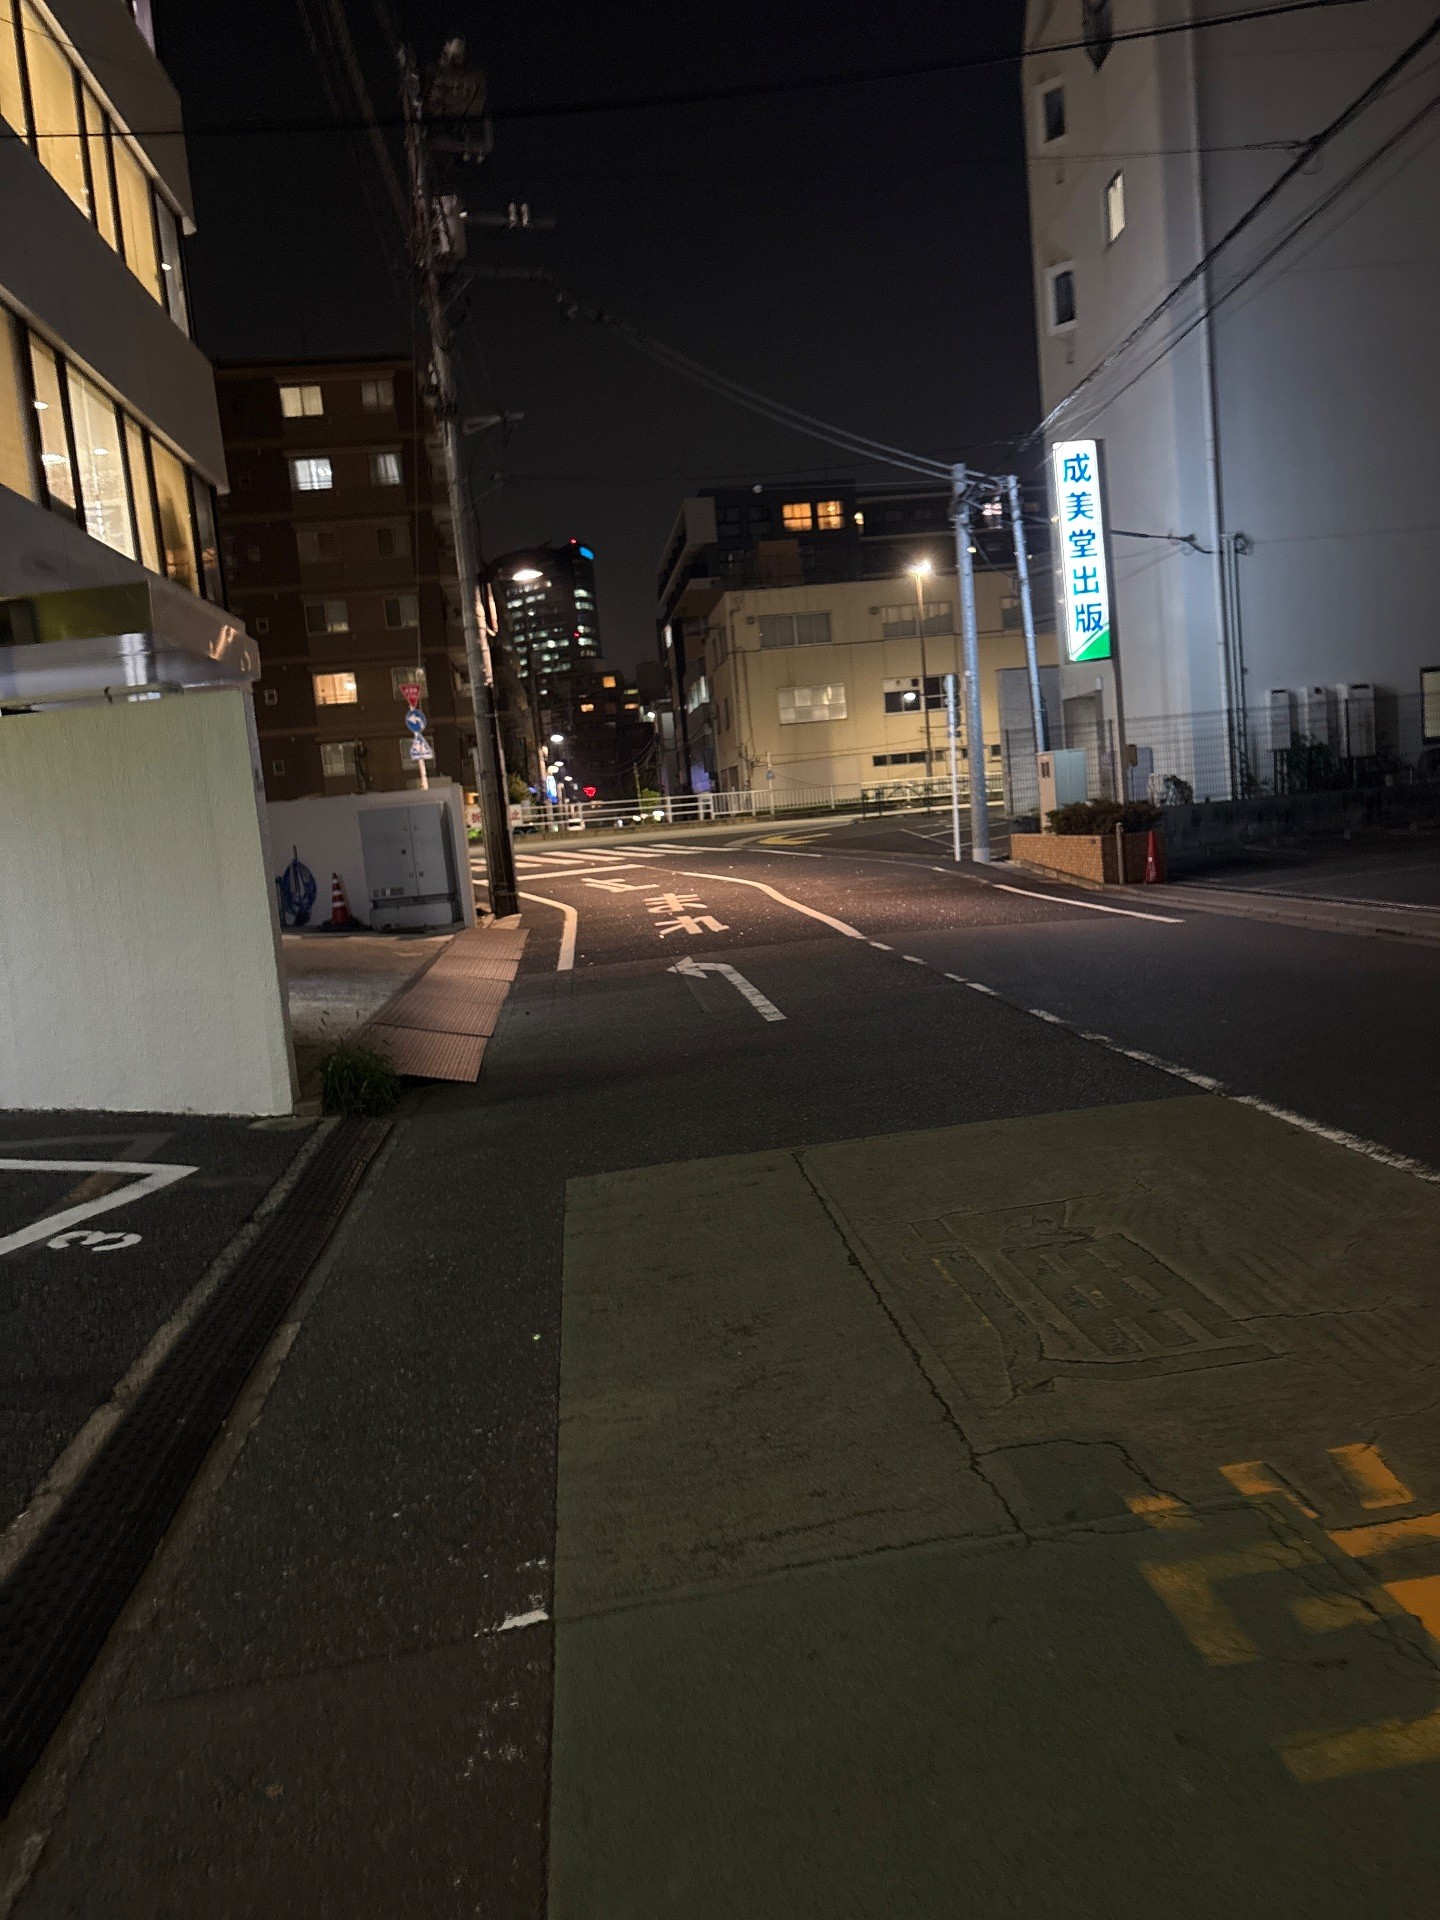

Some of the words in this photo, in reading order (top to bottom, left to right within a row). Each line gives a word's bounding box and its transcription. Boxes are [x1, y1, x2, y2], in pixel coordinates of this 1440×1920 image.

[1062, 453, 1103, 632] 成美堂出版
[581, 878, 730, 939] 止まれ
[46, 1230, 143, 1252] 3
